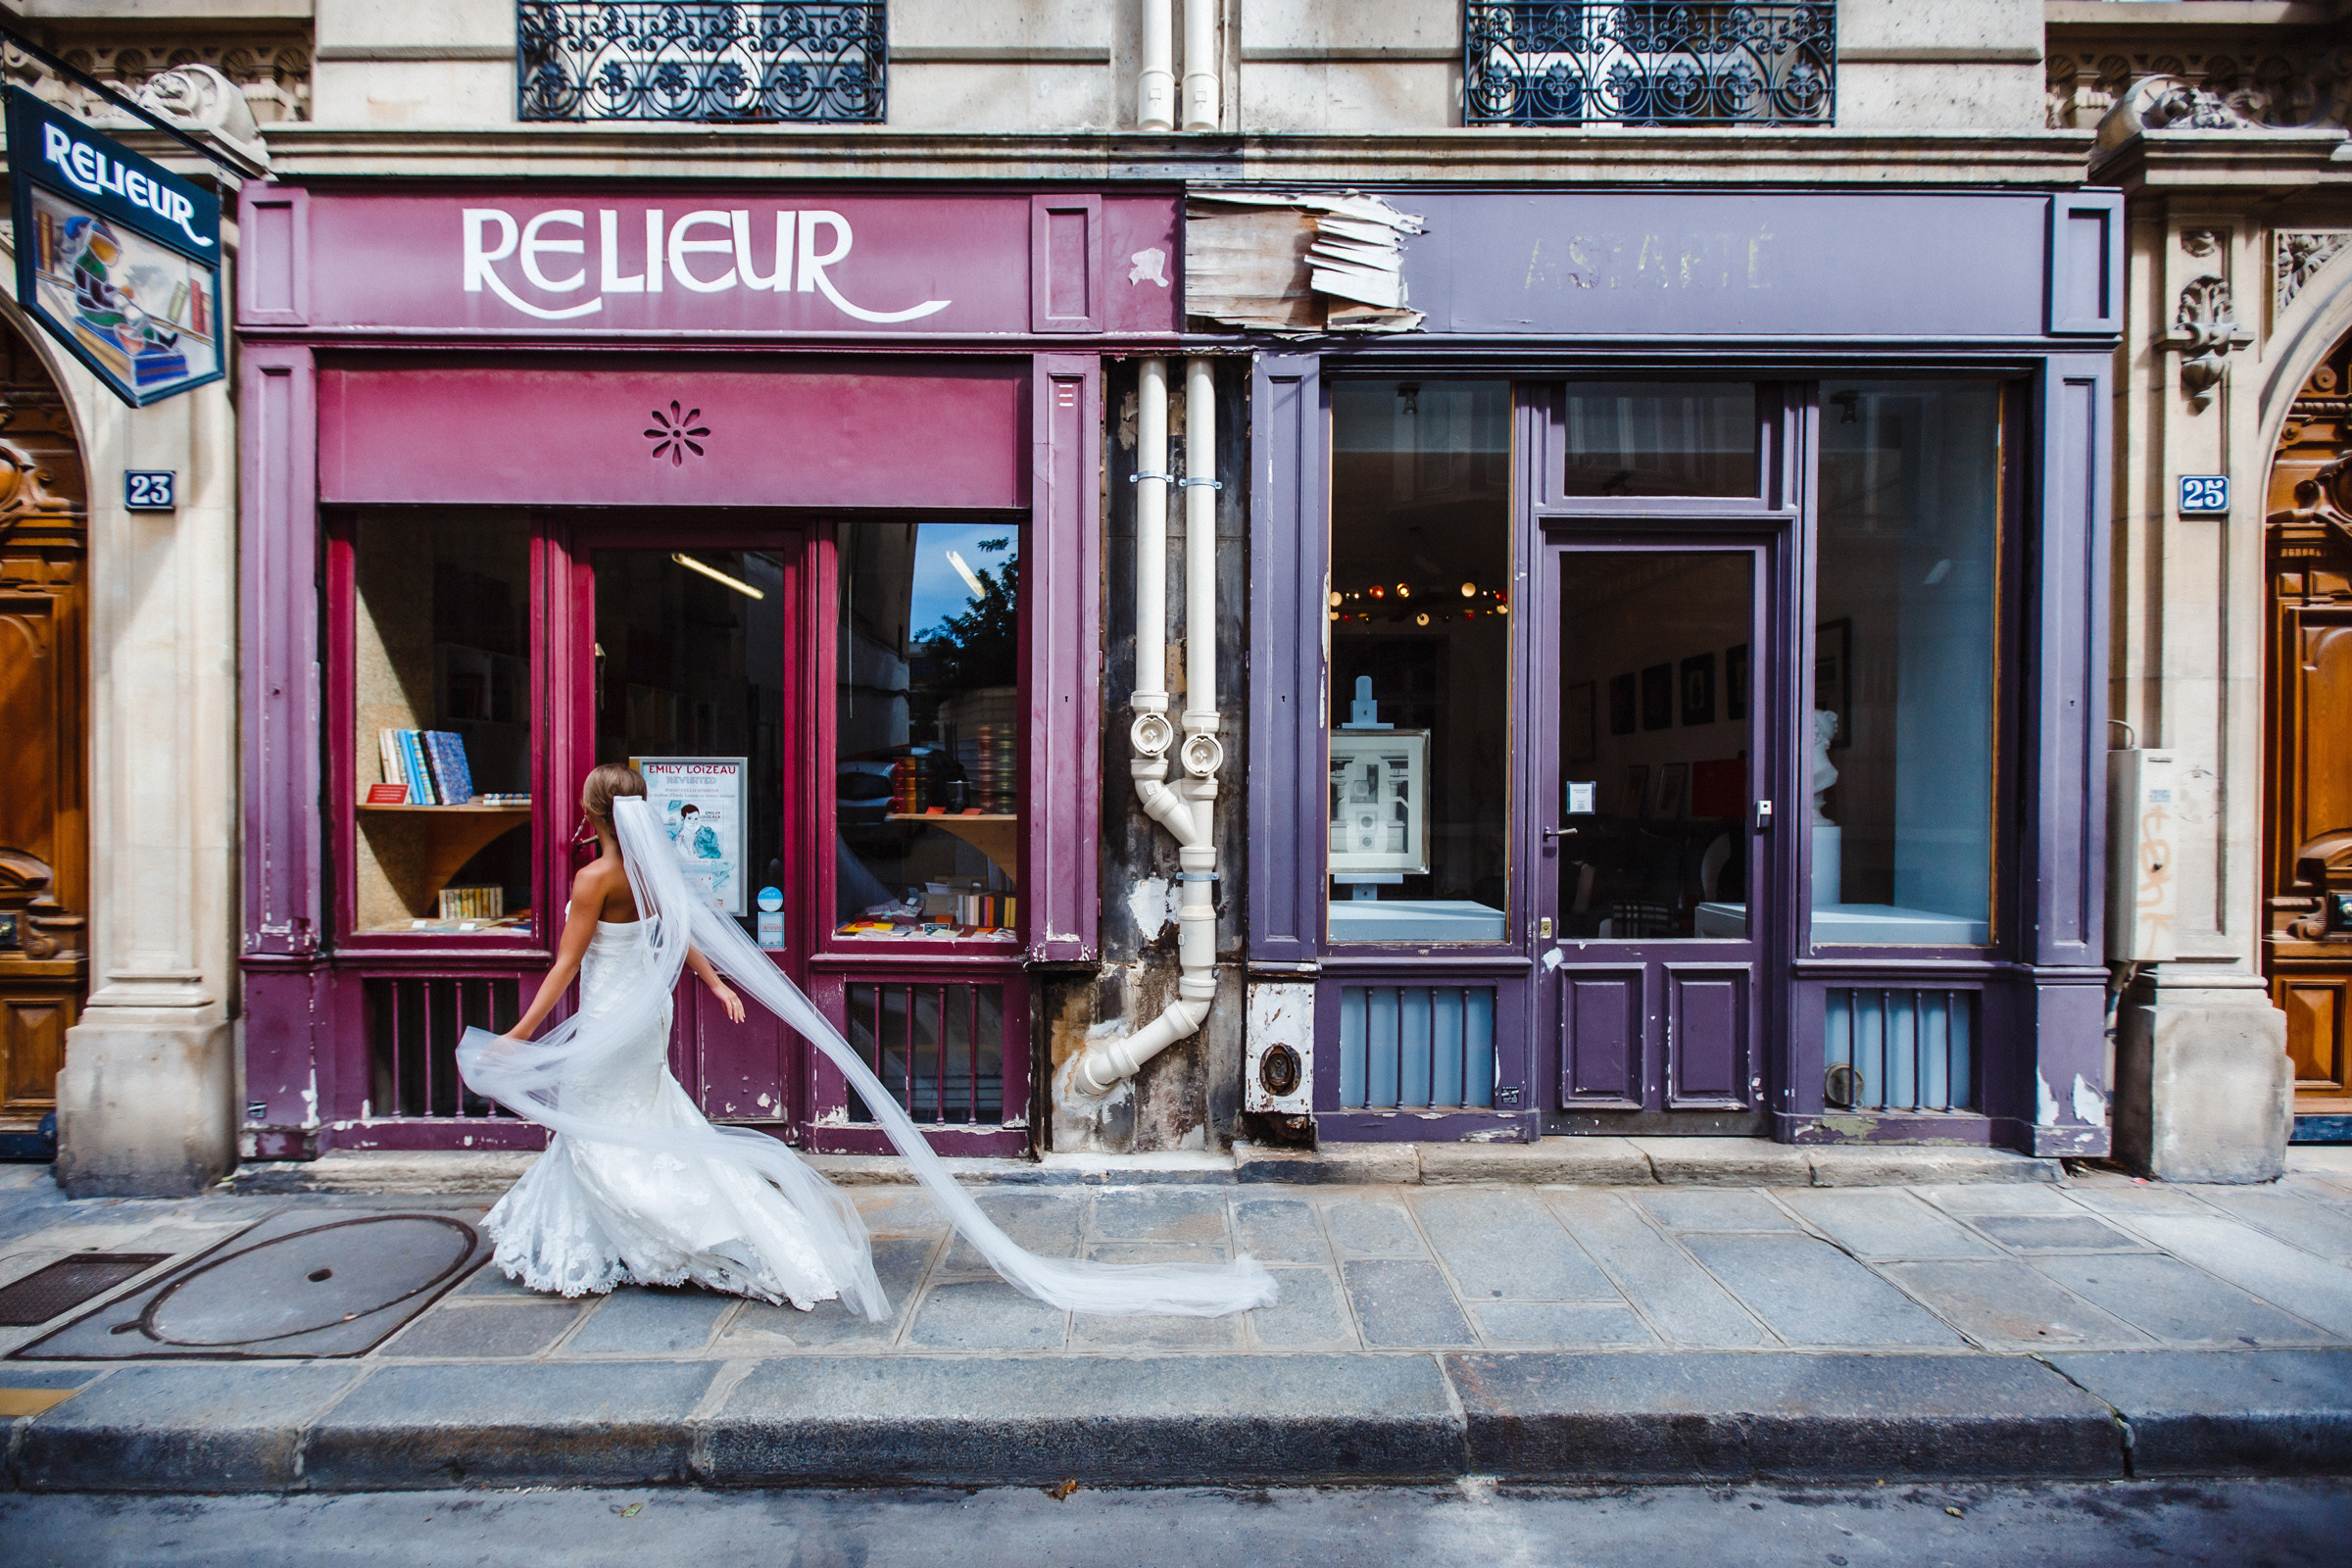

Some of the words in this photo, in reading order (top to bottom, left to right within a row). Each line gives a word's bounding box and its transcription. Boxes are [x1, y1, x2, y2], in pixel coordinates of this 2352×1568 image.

[44, 122, 214, 248] RELIEUR
[462, 208, 953, 322] RELIEUR
[130, 475, 170, 504] 23
[2183, 480, 2225, 507] 25
